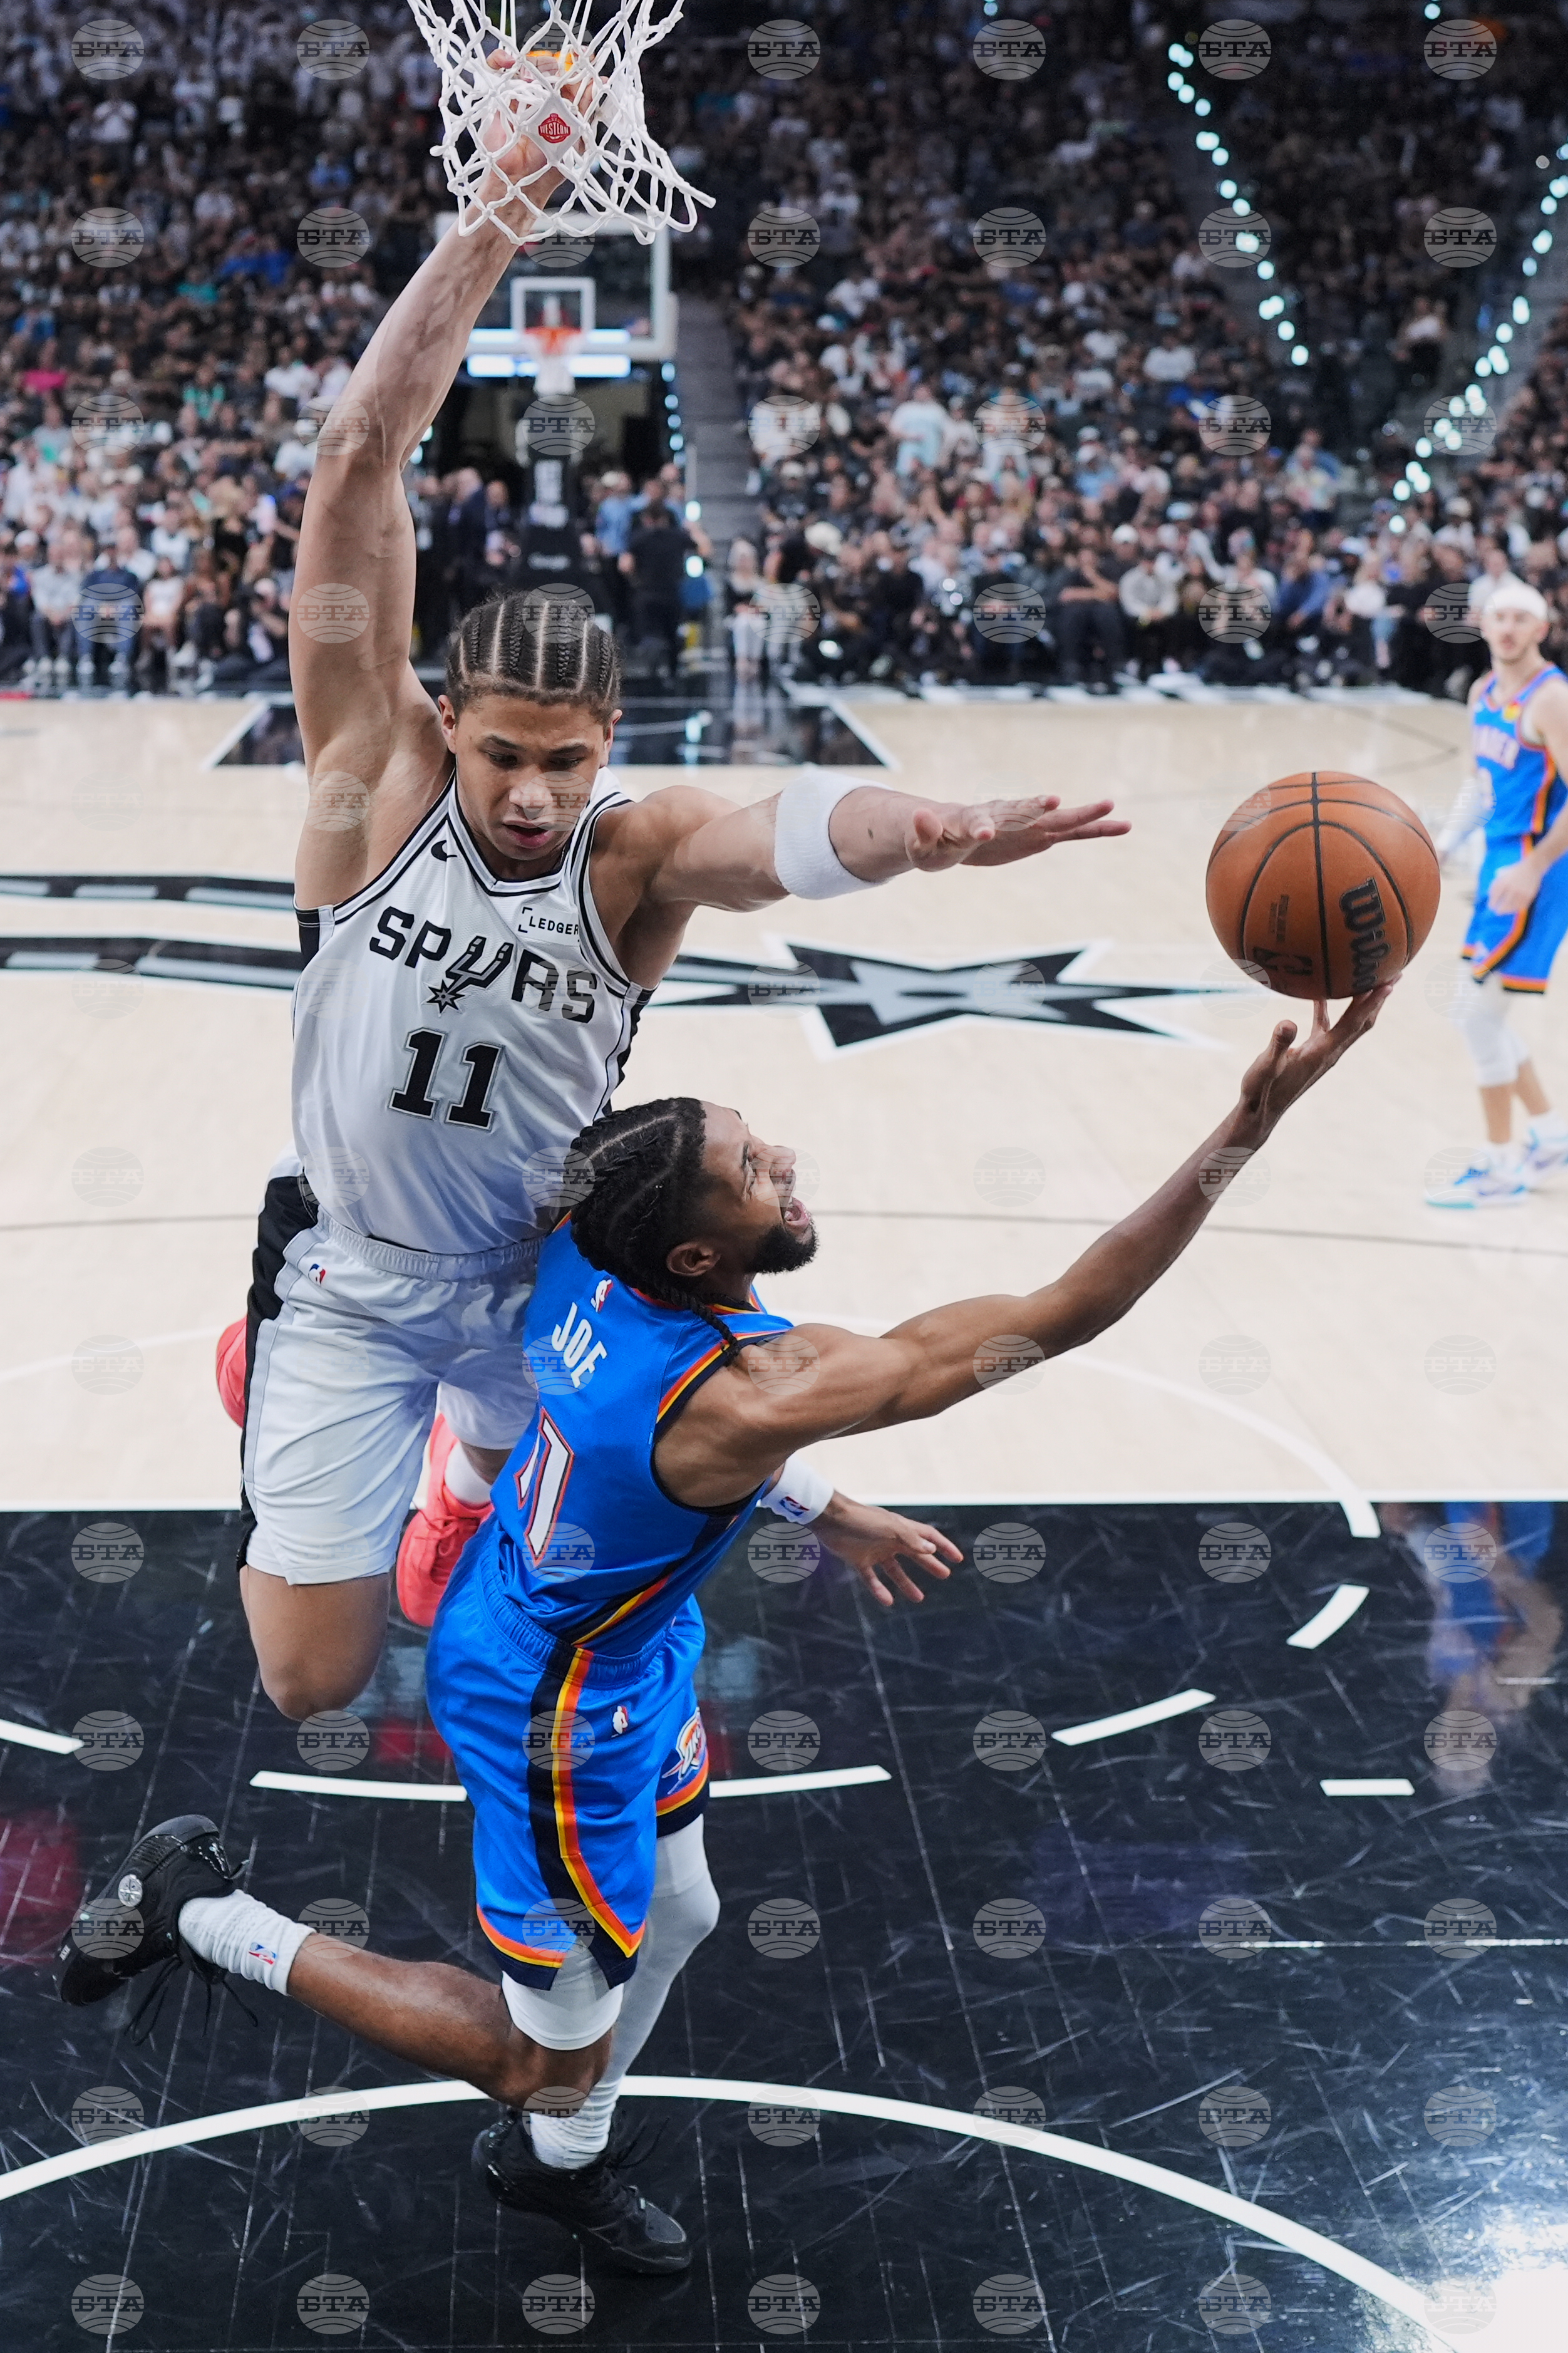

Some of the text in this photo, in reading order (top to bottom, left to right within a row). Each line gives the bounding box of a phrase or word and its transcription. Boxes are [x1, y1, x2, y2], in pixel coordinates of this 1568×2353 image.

[369, 906, 597, 1024] SPURS
[529, 916, 579, 935] LEDGER
[1339, 877, 1391, 991] Wil
[388, 1027, 503, 1130] 11
[551, 1301, 607, 1388] JOE
